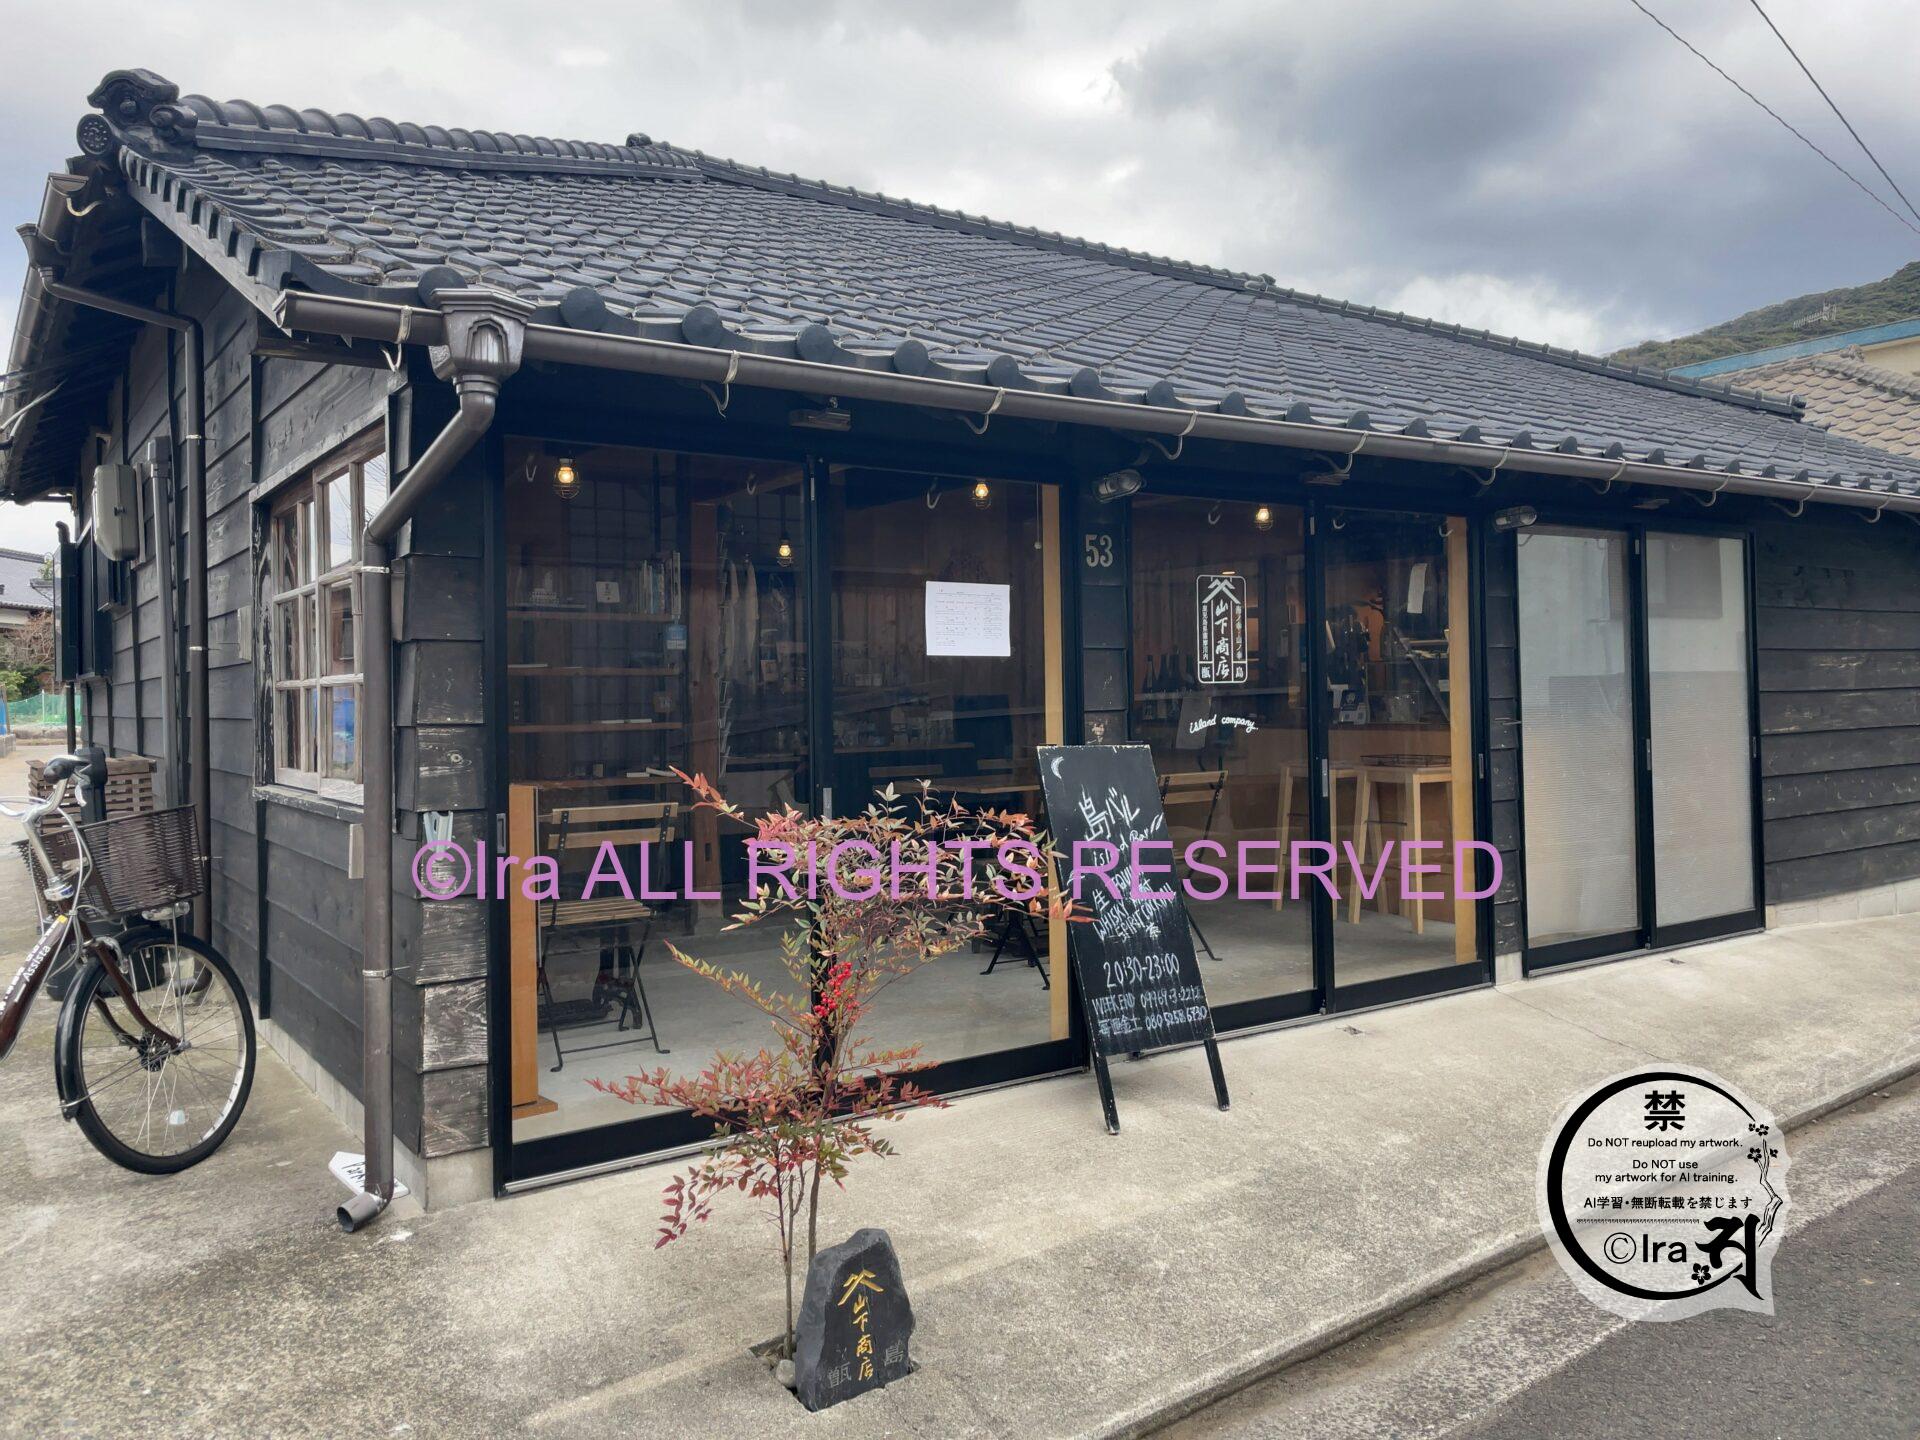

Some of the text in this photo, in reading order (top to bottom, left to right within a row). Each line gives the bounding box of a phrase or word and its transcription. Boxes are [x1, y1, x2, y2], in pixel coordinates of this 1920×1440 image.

[1085, 534, 1114, 568] 53
[1214, 598, 1230, 680] 山下商店
[1189, 714, 1217, 734] island
[22, 945, 51, 982] Assista
[851, 1293, 875, 1382] 山下商店
